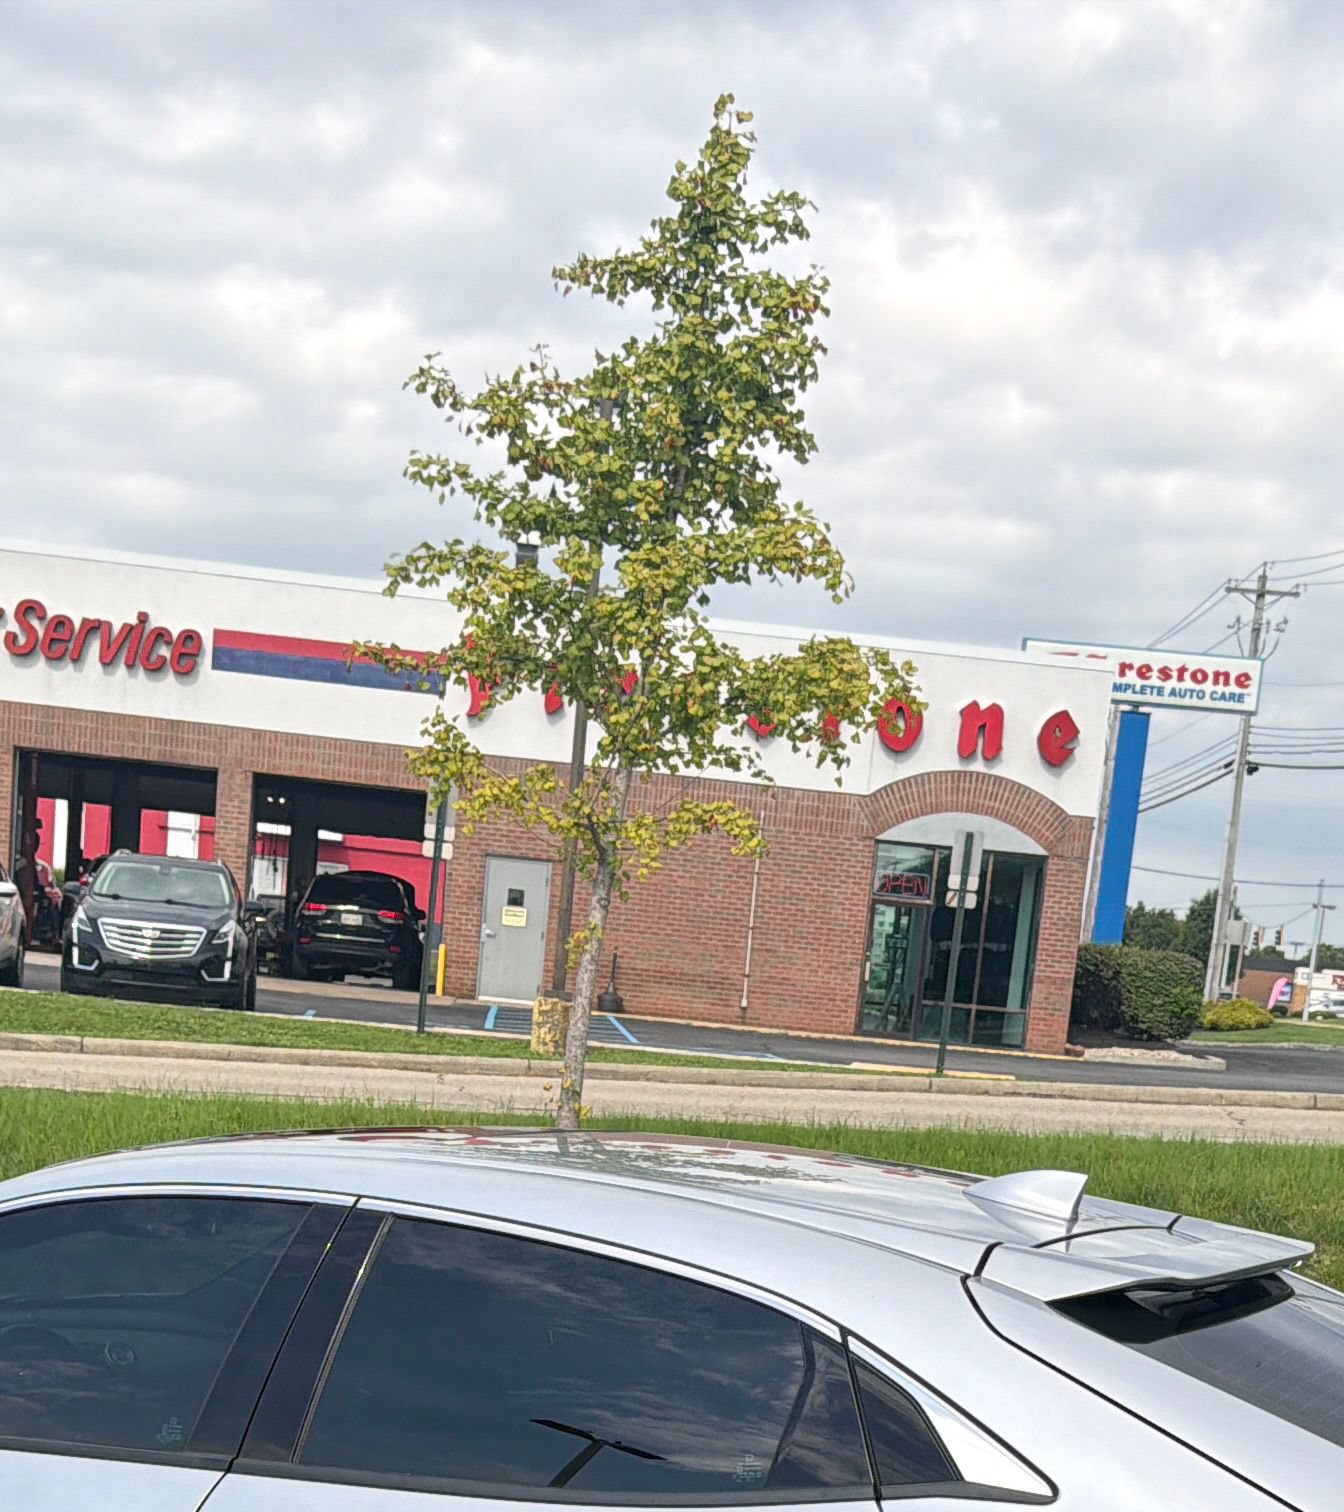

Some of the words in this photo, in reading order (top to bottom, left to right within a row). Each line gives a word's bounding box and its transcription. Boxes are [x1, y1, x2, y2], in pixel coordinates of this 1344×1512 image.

[4, 599, 202, 674] Service
[1112, 682, 1165, 698] MPLETE
[1168, 686, 1206, 700] AUTO
[1209, 690, 1246, 704] CARE
